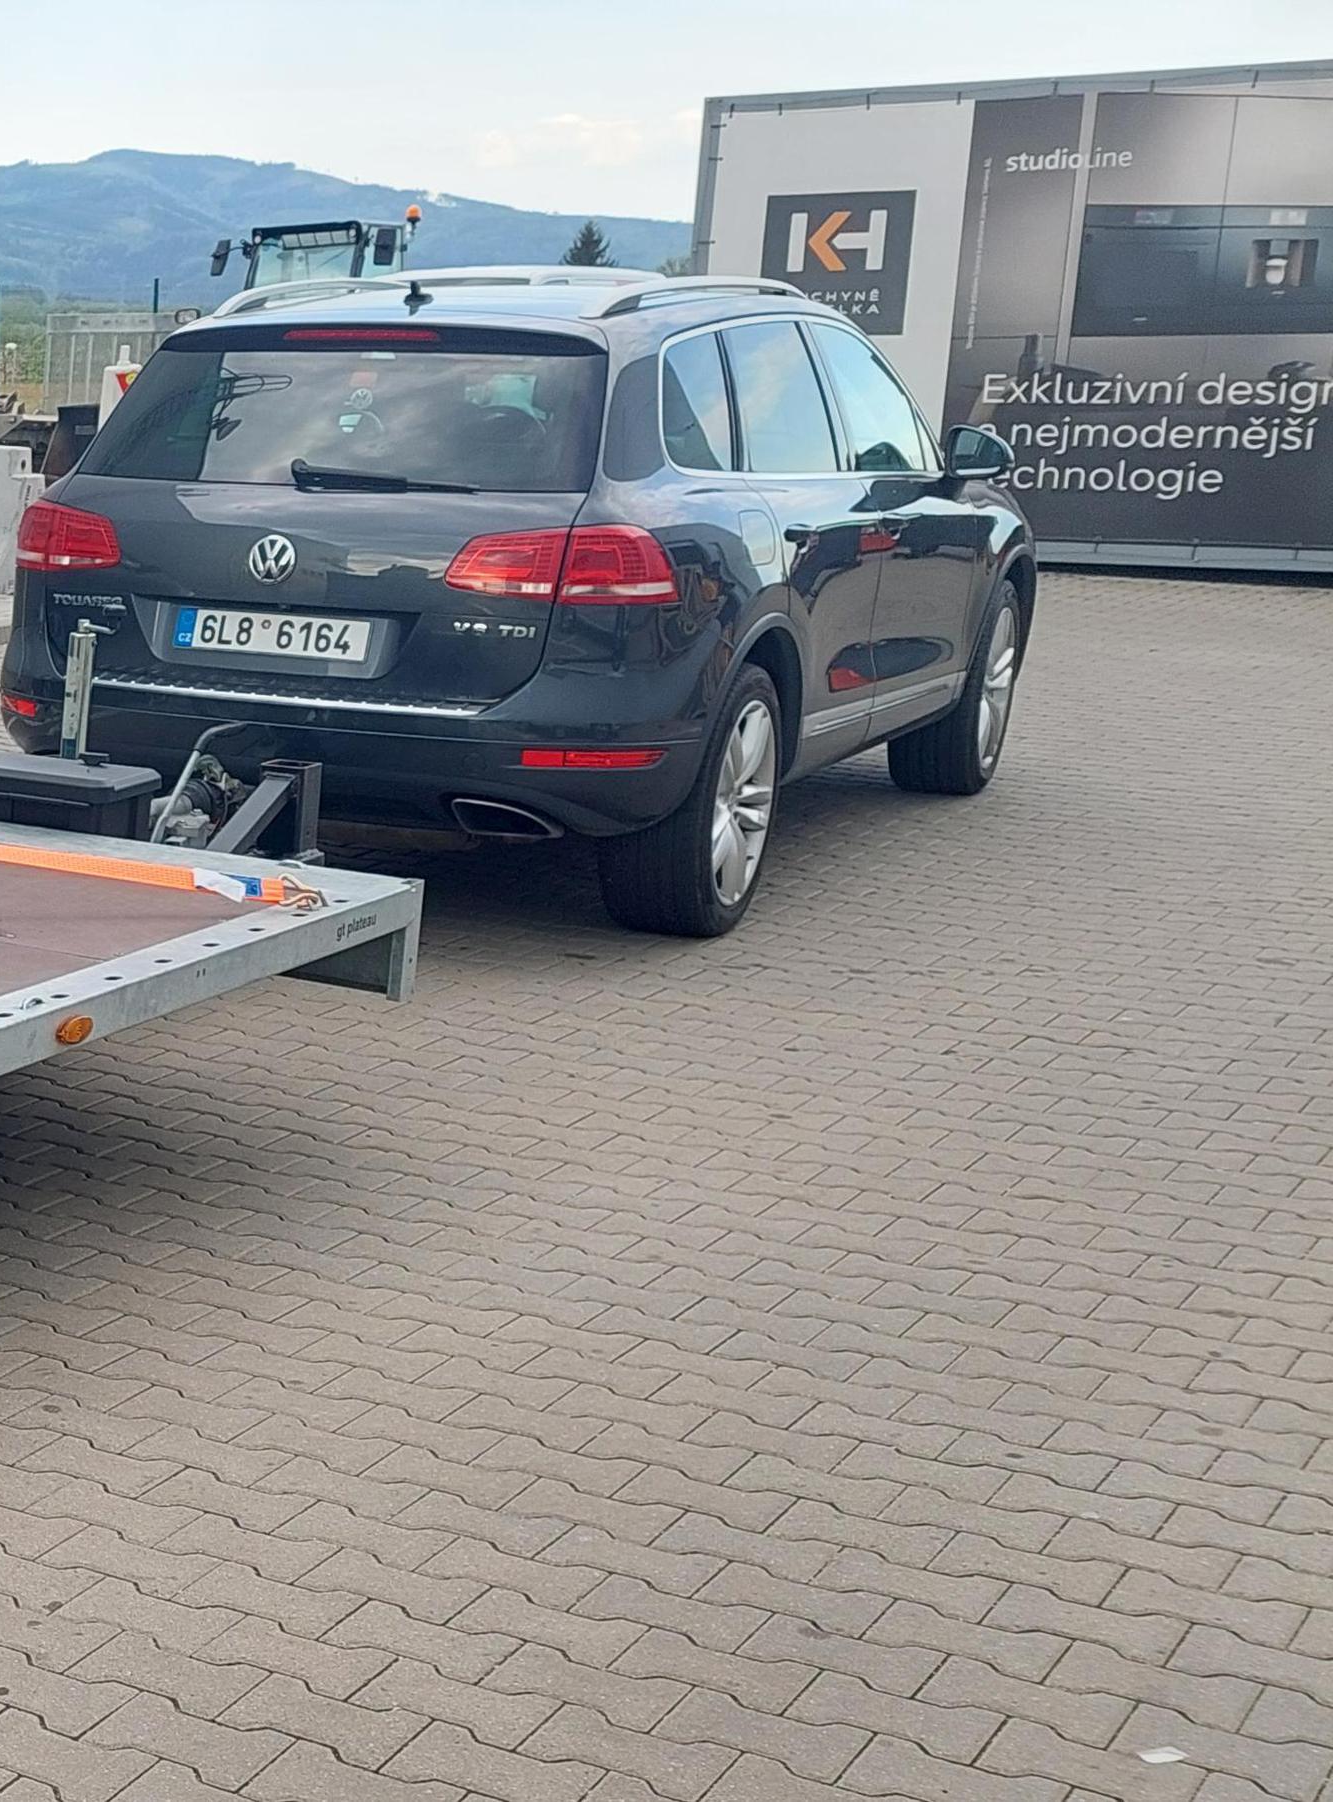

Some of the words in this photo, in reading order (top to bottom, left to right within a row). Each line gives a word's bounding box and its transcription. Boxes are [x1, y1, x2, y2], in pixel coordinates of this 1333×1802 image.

[786, 209, 888, 273] KH
[805, 287, 880, 302] CHYNĚ
[982, 372, 1189, 405] Exkluzivní
[1010, 416, 1319, 458] nejmodernější
[988, 457, 1224, 500] echnologie
[178, 633, 192, 643] CZ
[200, 614, 254, 646] 6L8
[276, 619, 351, 655] 6164
[498, 624, 536, 638] TDI
